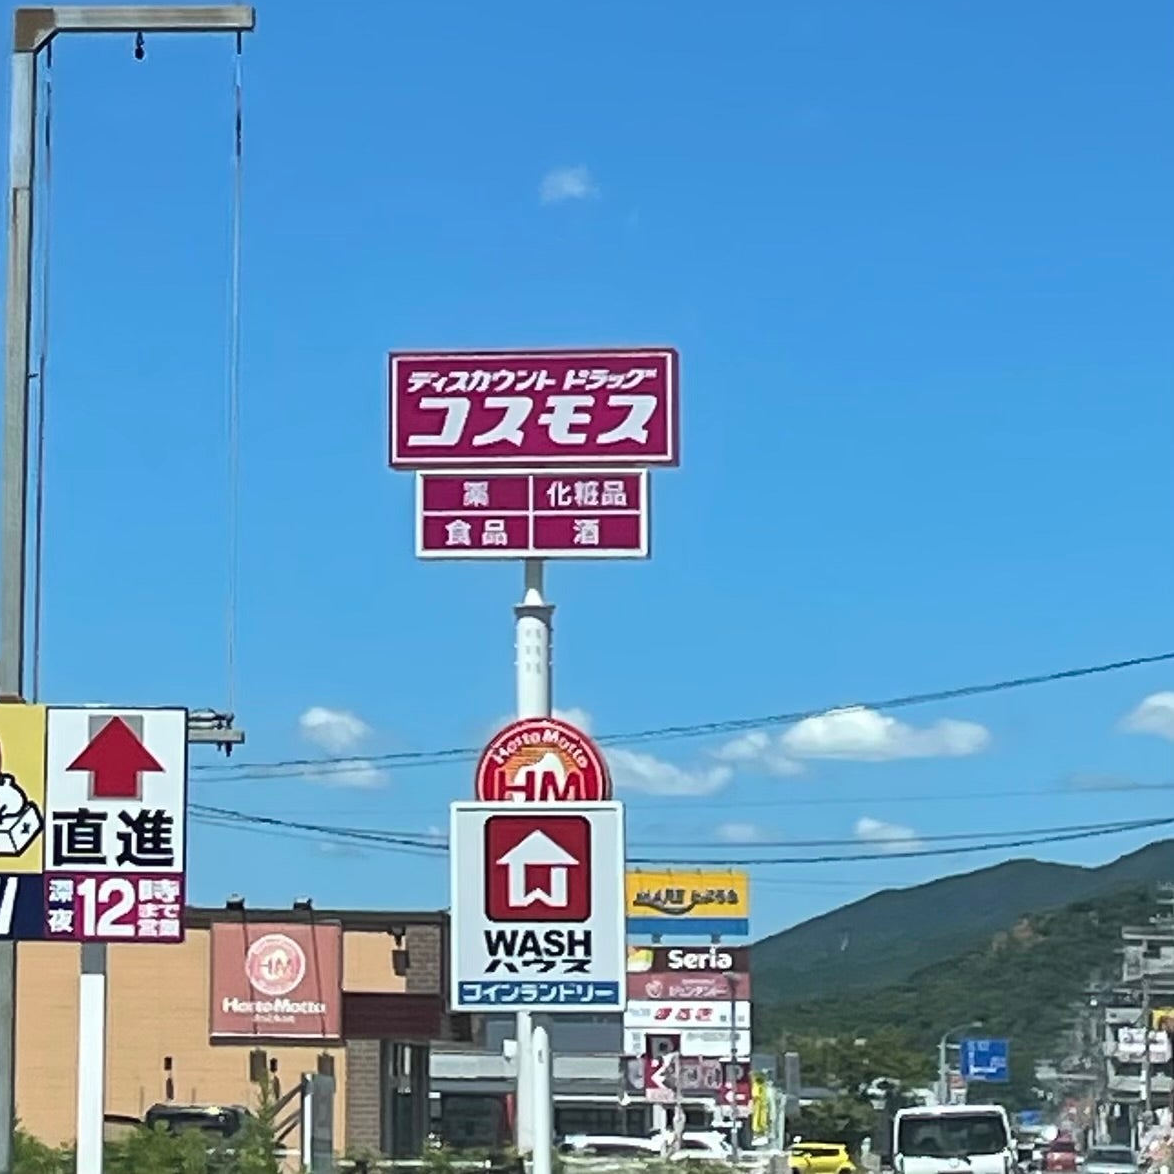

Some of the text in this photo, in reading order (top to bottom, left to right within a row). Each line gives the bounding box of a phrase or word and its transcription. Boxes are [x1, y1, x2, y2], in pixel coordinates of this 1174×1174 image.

[407, 369, 658, 392] ディスカウント ドラッグ
[407, 395, 658, 447] コスモス
[463, 481, 489, 507] 薬
[547, 480, 628, 507] 化粧品
[445, 519, 508, 546] 食品
[573, 519, 600, 546] 酒
[52, 809, 175, 867] 直進
[48, 879, 74, 933] 深夜
[77, 878, 136, 936] 12
[484, 929, 592, 957] WASH
[485, 958, 592, 974] ハウス
[668, 947, 733, 971] Seria
[463, 983, 614, 1003] コインランドリー
